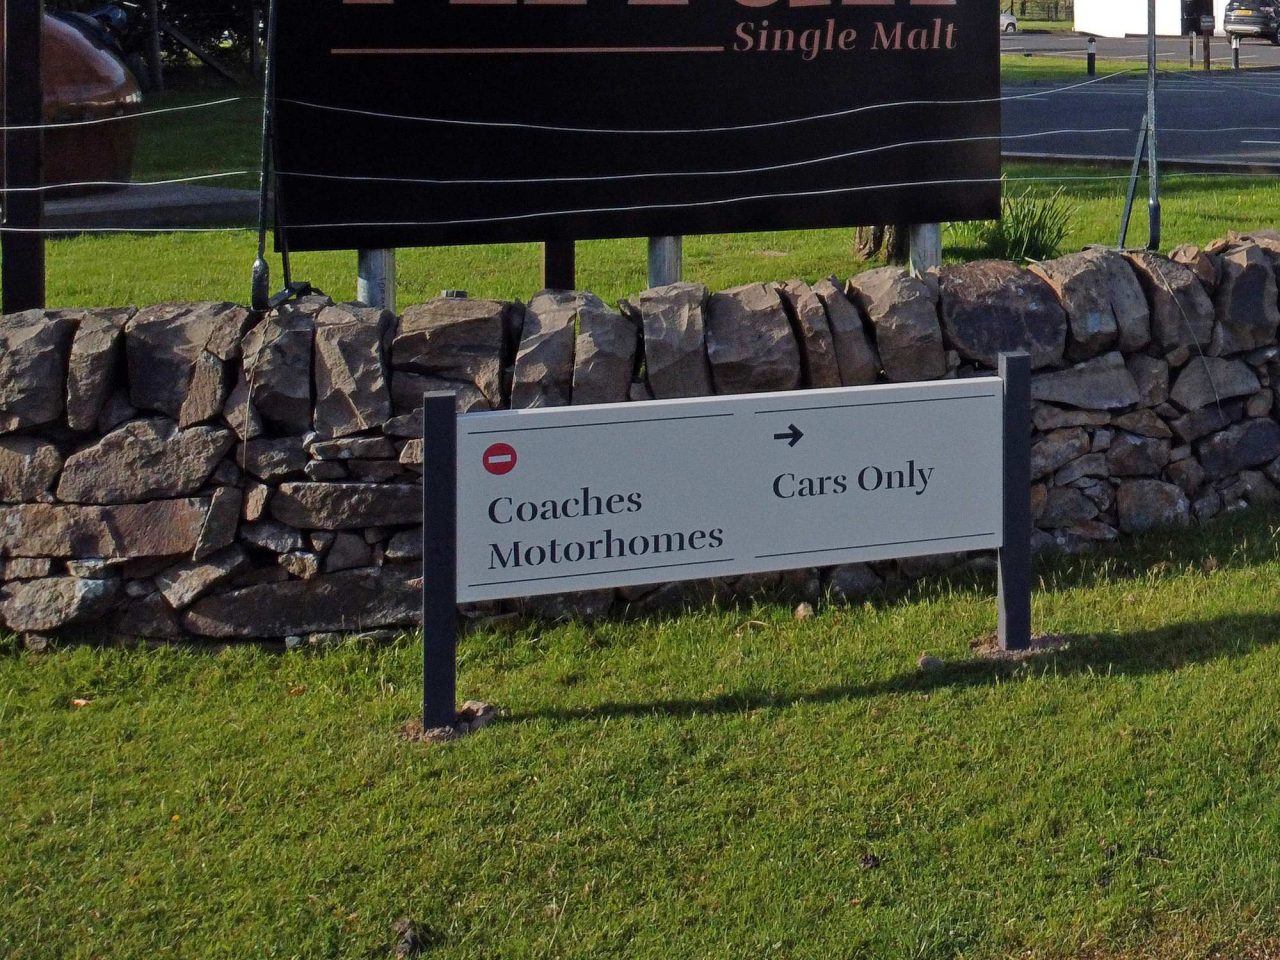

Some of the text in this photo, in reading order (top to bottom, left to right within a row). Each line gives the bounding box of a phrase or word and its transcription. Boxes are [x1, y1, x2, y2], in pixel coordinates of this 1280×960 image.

[733, 18, 957, 60] Single Malt
[772, 459, 935, 499] Cars Only
[487, 486, 643, 524] Coaches
[487, 526, 724, 570] Motorhomes
